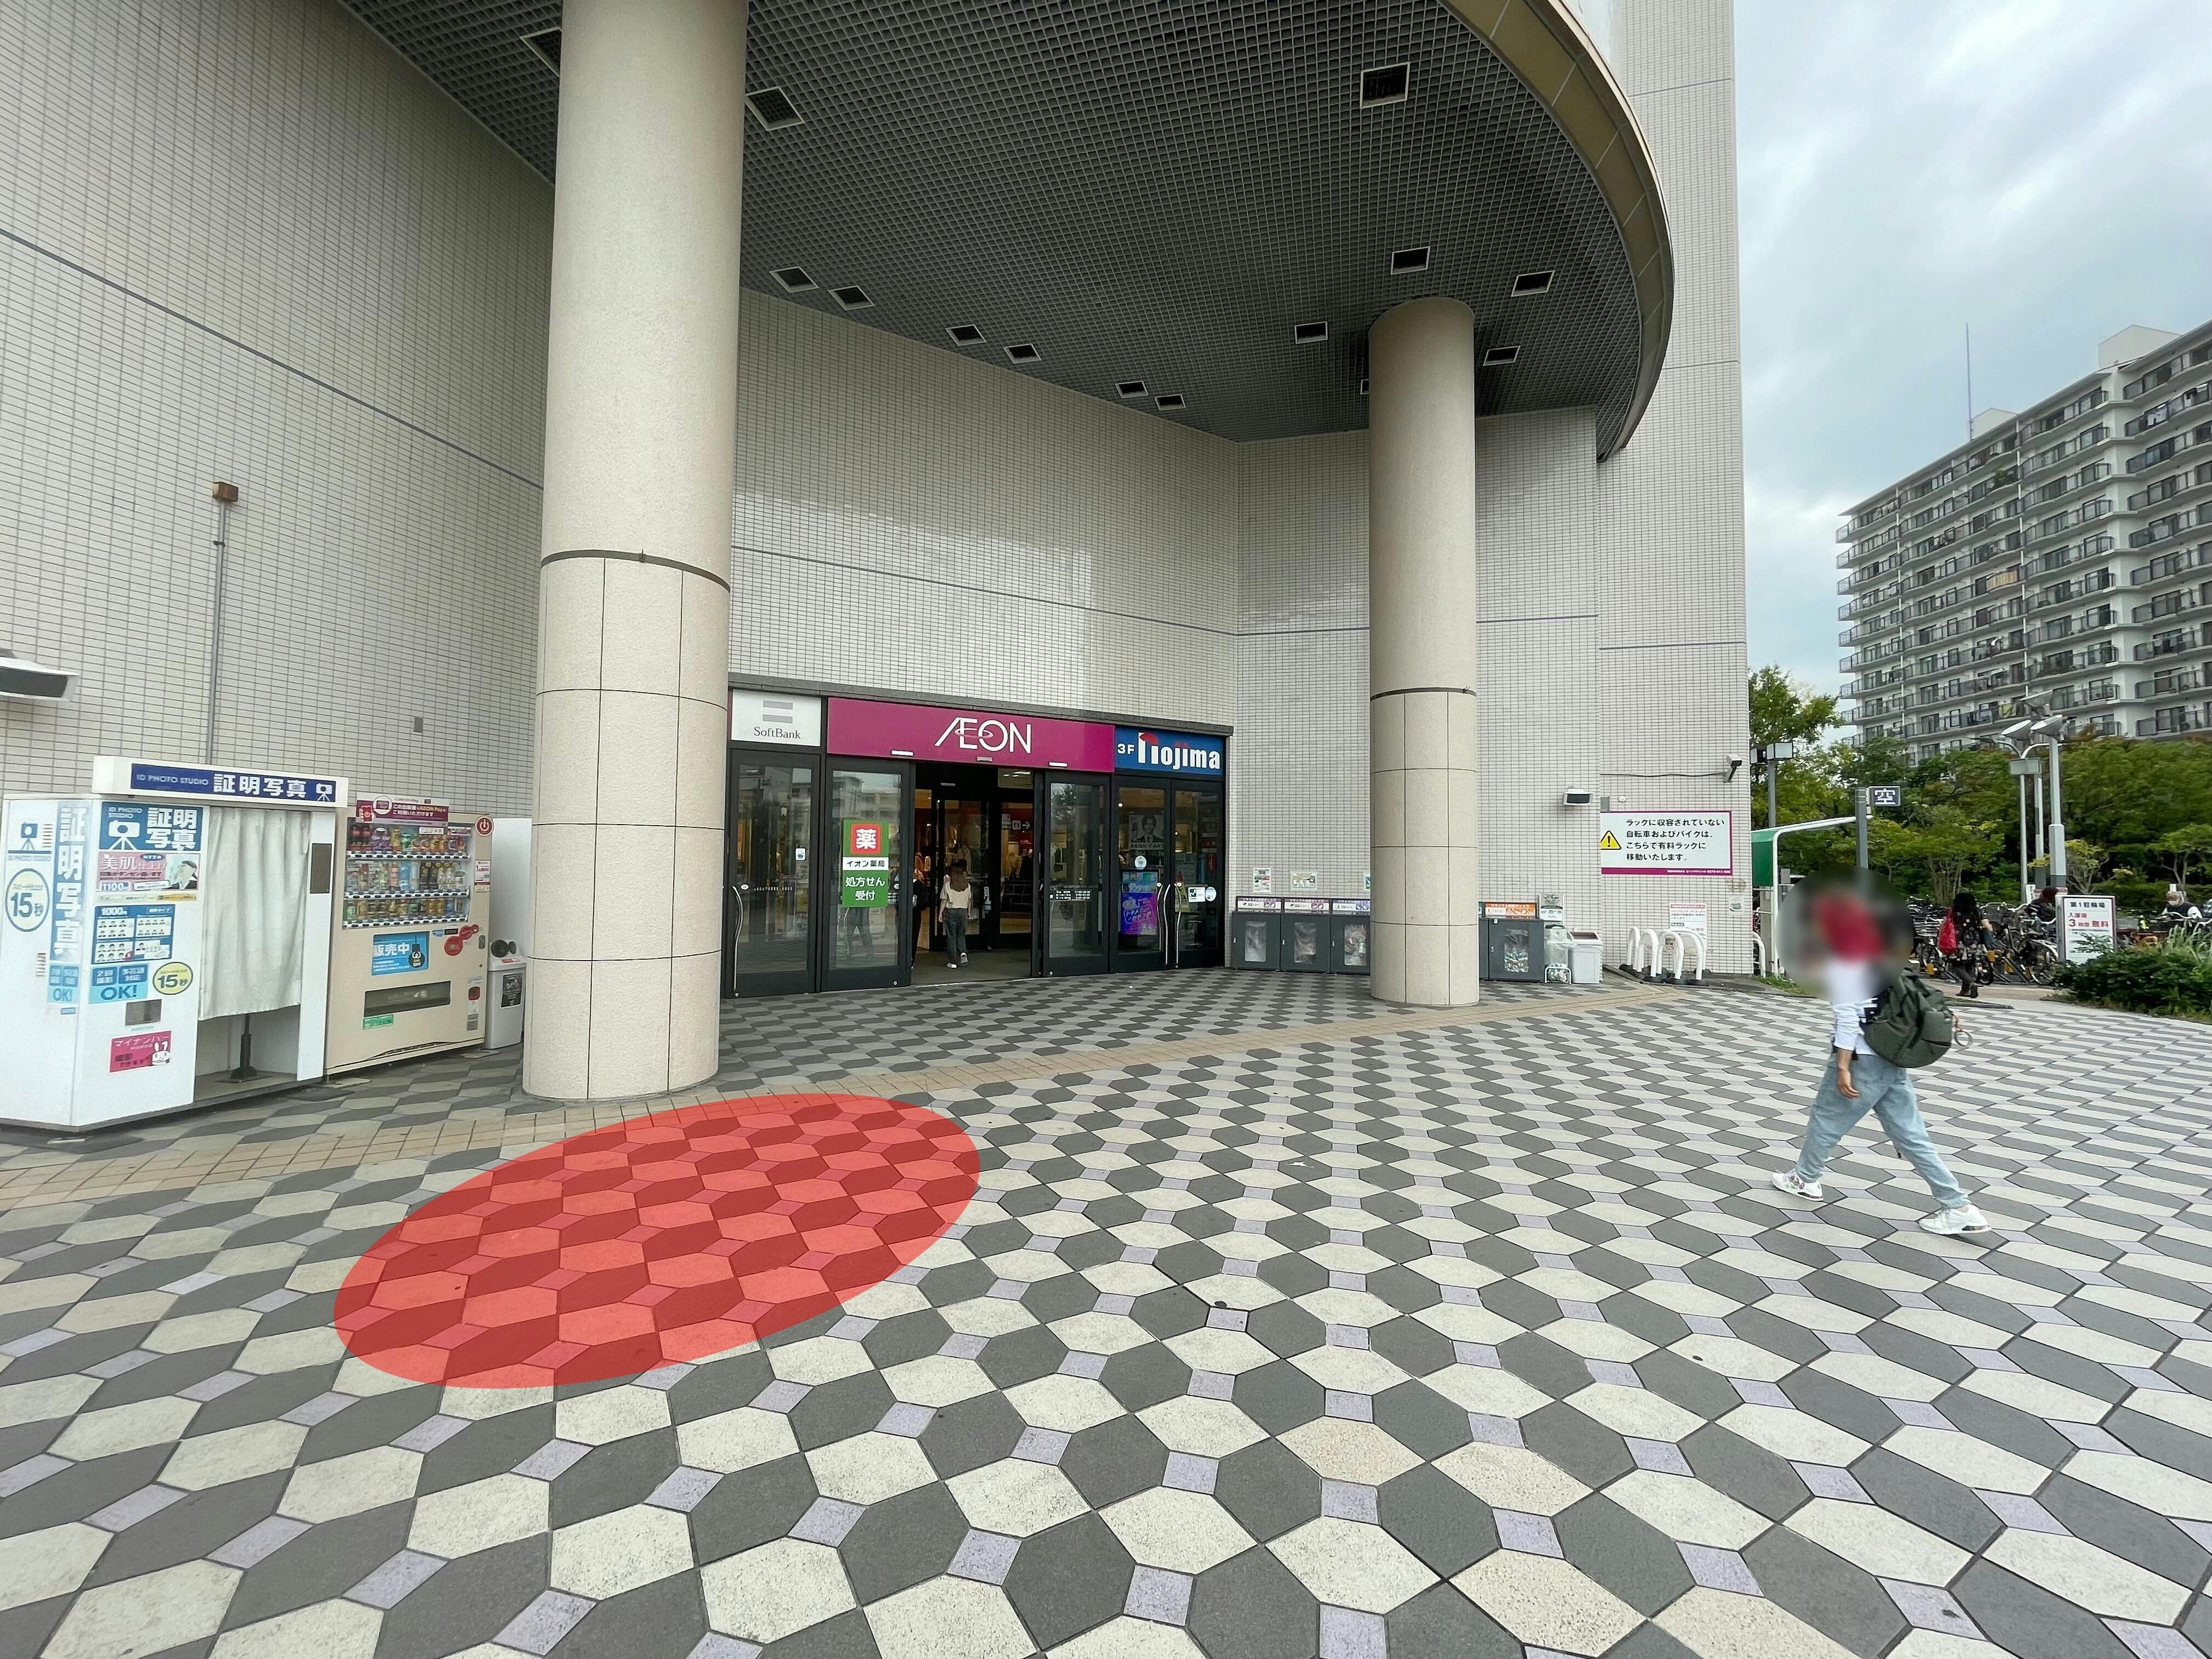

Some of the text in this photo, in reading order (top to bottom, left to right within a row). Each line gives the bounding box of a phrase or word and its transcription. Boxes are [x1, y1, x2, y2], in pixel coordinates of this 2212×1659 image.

[754, 726, 801, 739] SoftBank
[1118, 743, 1135, 754] 3F
[148, 775, 178, 783] PHOTO
[213, 773, 307, 798] 証明写真
[1874, 788, 1895, 805] 空
[148, 807, 197, 829] 証明
[1626, 819, 1724, 827] ラックに収容されていない
[145, 828, 196, 850] 写真
[855, 828, 877, 850] 薬
[54, 808, 87, 955] 証明写真
[845, 877, 885, 887] 処方せん
[855, 890, 876, 901] 受付
[373, 942, 410, 957] 販売中
[101, 985, 137, 1000] OK!
[114, 1036, 170, 1047] マイナンバー
